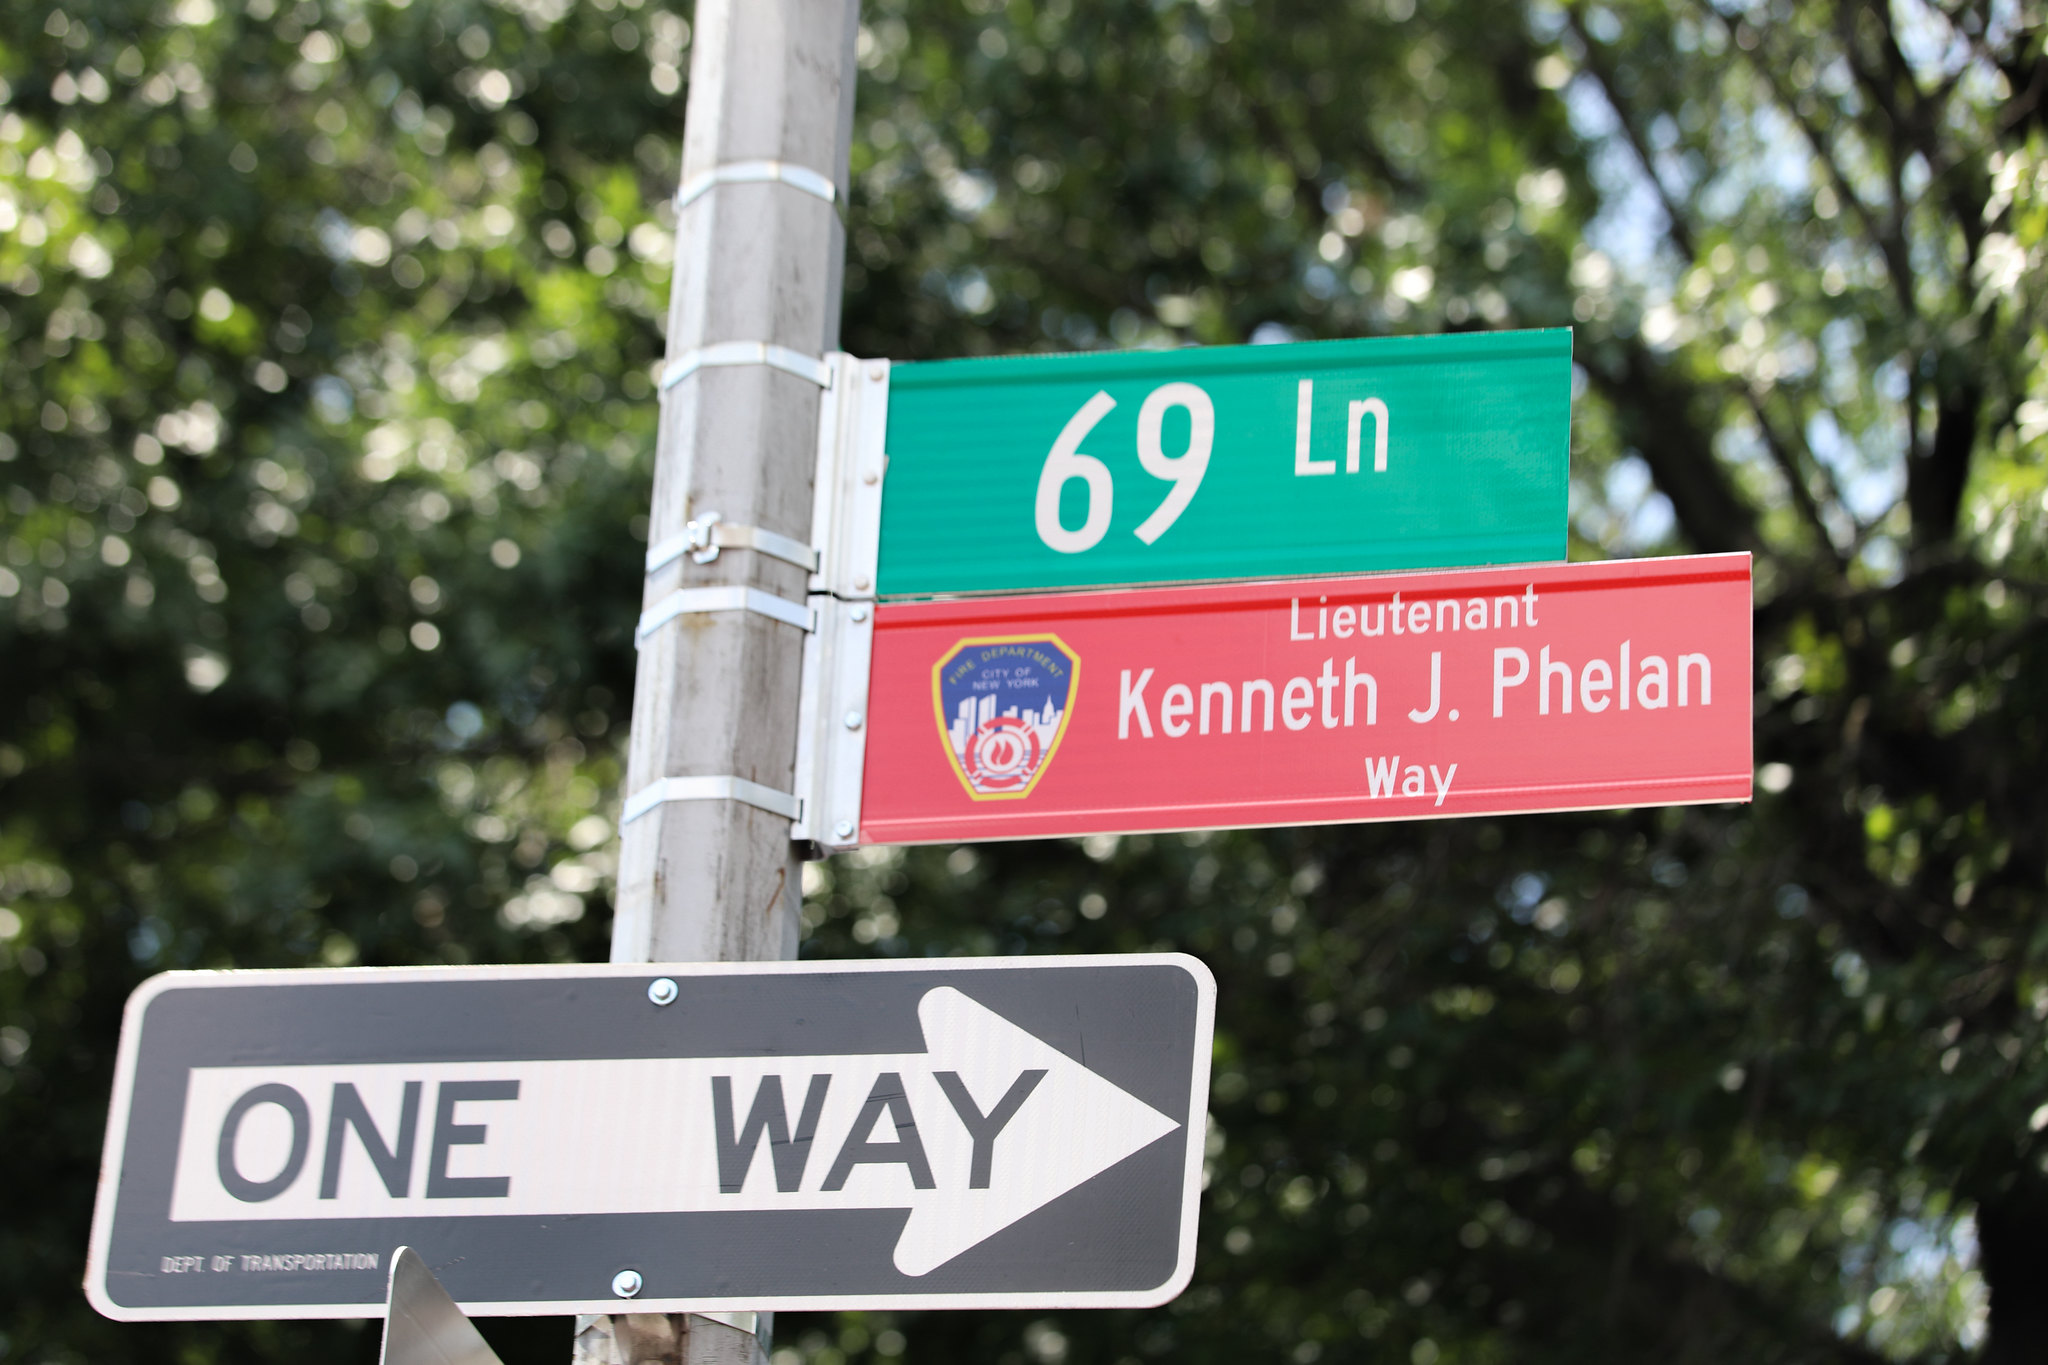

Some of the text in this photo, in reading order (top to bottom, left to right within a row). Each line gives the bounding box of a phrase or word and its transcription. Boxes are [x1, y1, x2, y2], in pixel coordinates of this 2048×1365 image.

[1034, 378, 1390, 554] 69 Ln
[1289, 584, 1540, 642] Lieutenant
[949, 646, 1064, 685] FIRE DEPARTMENT
[973, 677, 1039, 691] NEW YORK
[982, 667, 1032, 679] CITY OF
[1117, 640, 1713, 741] Kenneth J. Phelan
[1365, 755, 1459, 808] Way
[217, 1069, 1049, 1203] ONE WAY
[210, 1255, 236, 1273] OF
[240, 1253, 379, 1273] TRANSPORTATION
